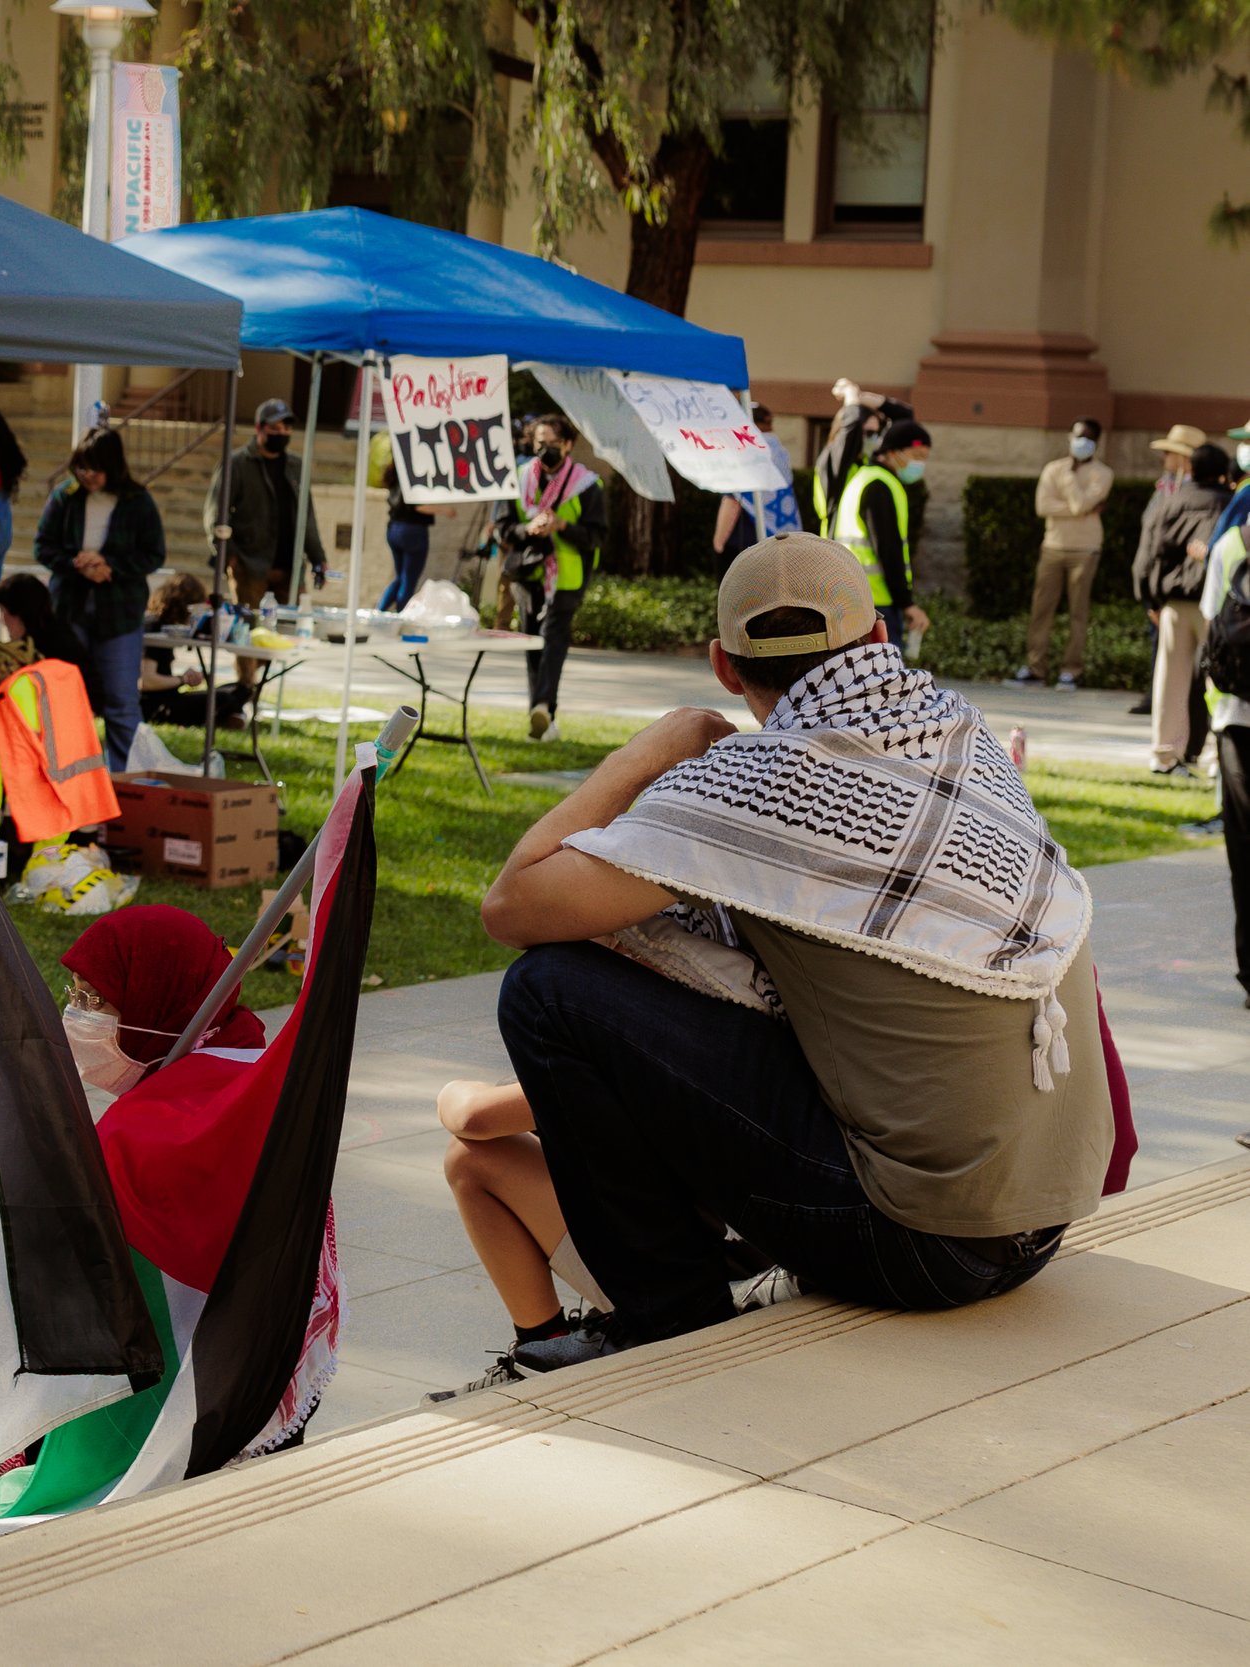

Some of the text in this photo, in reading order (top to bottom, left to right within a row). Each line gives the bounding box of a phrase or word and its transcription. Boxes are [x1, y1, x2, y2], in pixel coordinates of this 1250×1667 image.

[125, 118, 143, 208] PACIFIC
[395, 412, 511, 494] LIBRE
[678, 424, 767, 452] PALNE
